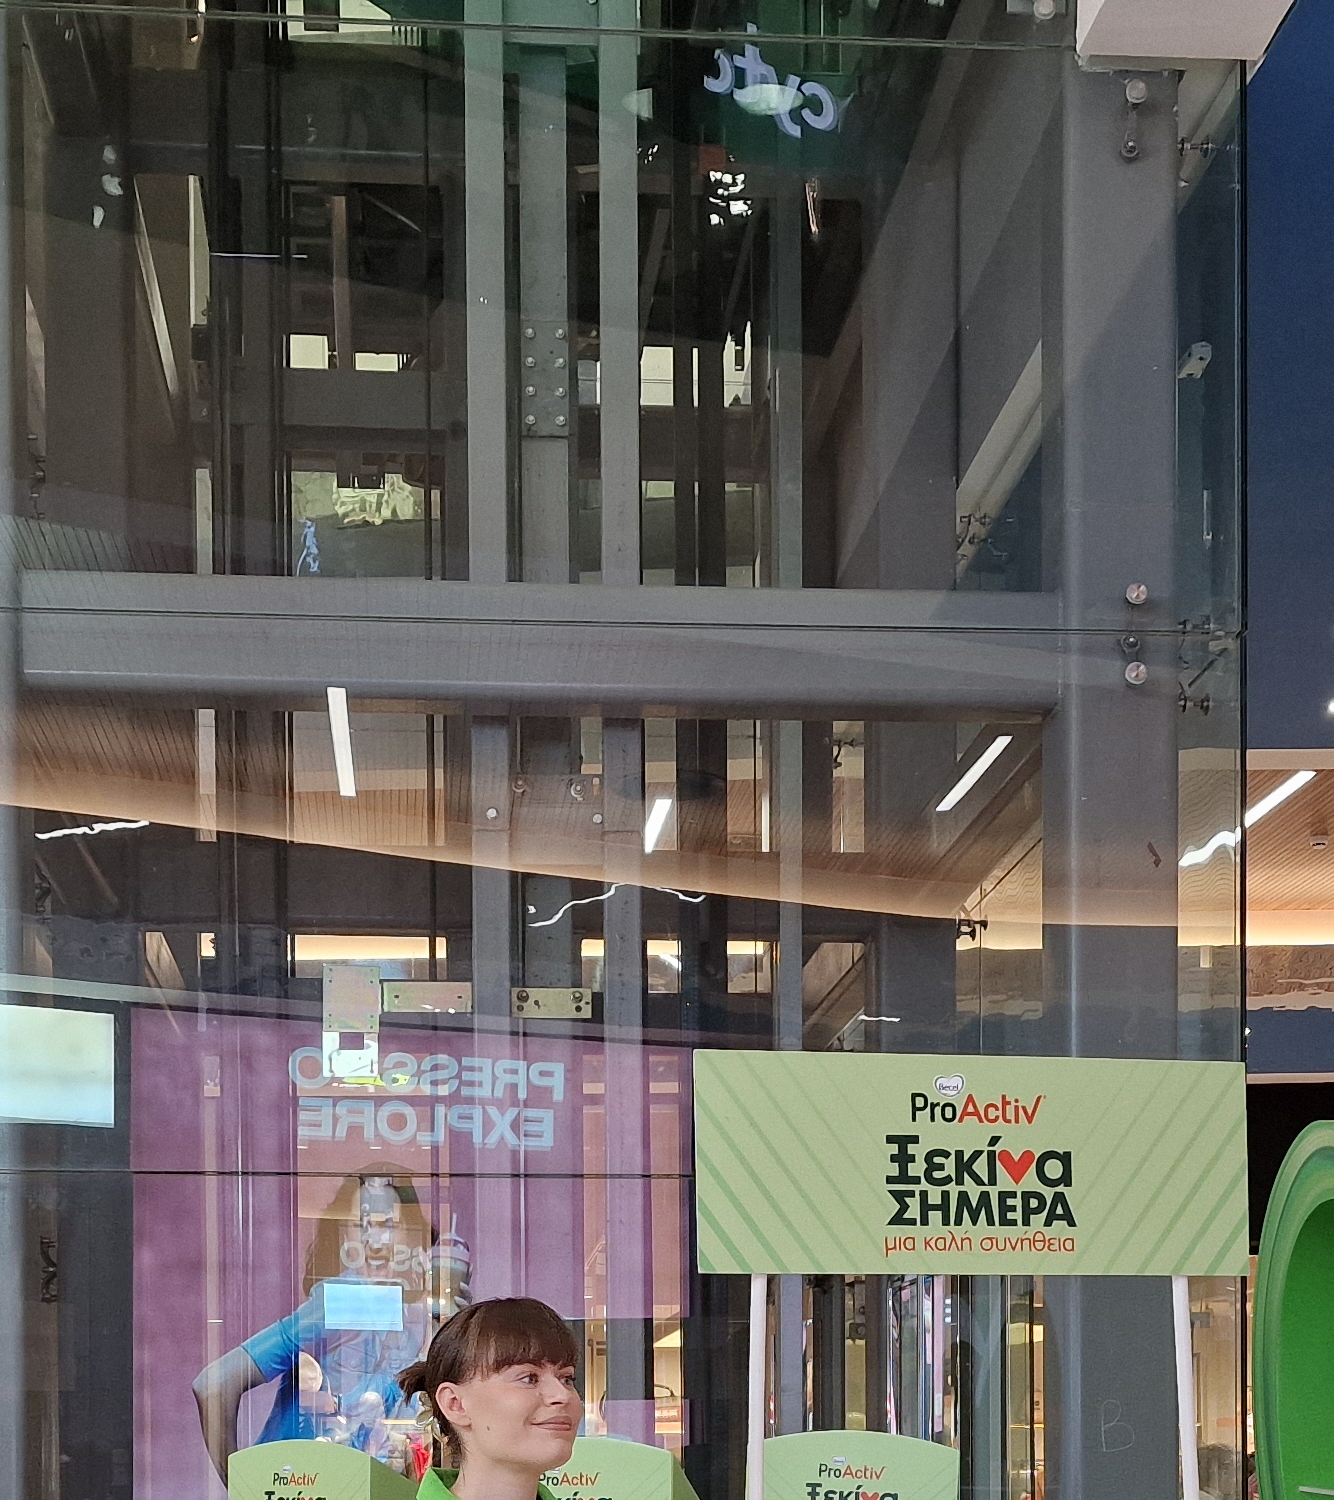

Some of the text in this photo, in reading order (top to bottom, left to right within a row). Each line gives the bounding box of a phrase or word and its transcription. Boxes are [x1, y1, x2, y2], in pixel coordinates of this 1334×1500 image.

[885, 1188, 1077, 1227] ΣΗΜΕΡΑ
[884, 1230, 1075, 1258] μια καλή συνήθεια
